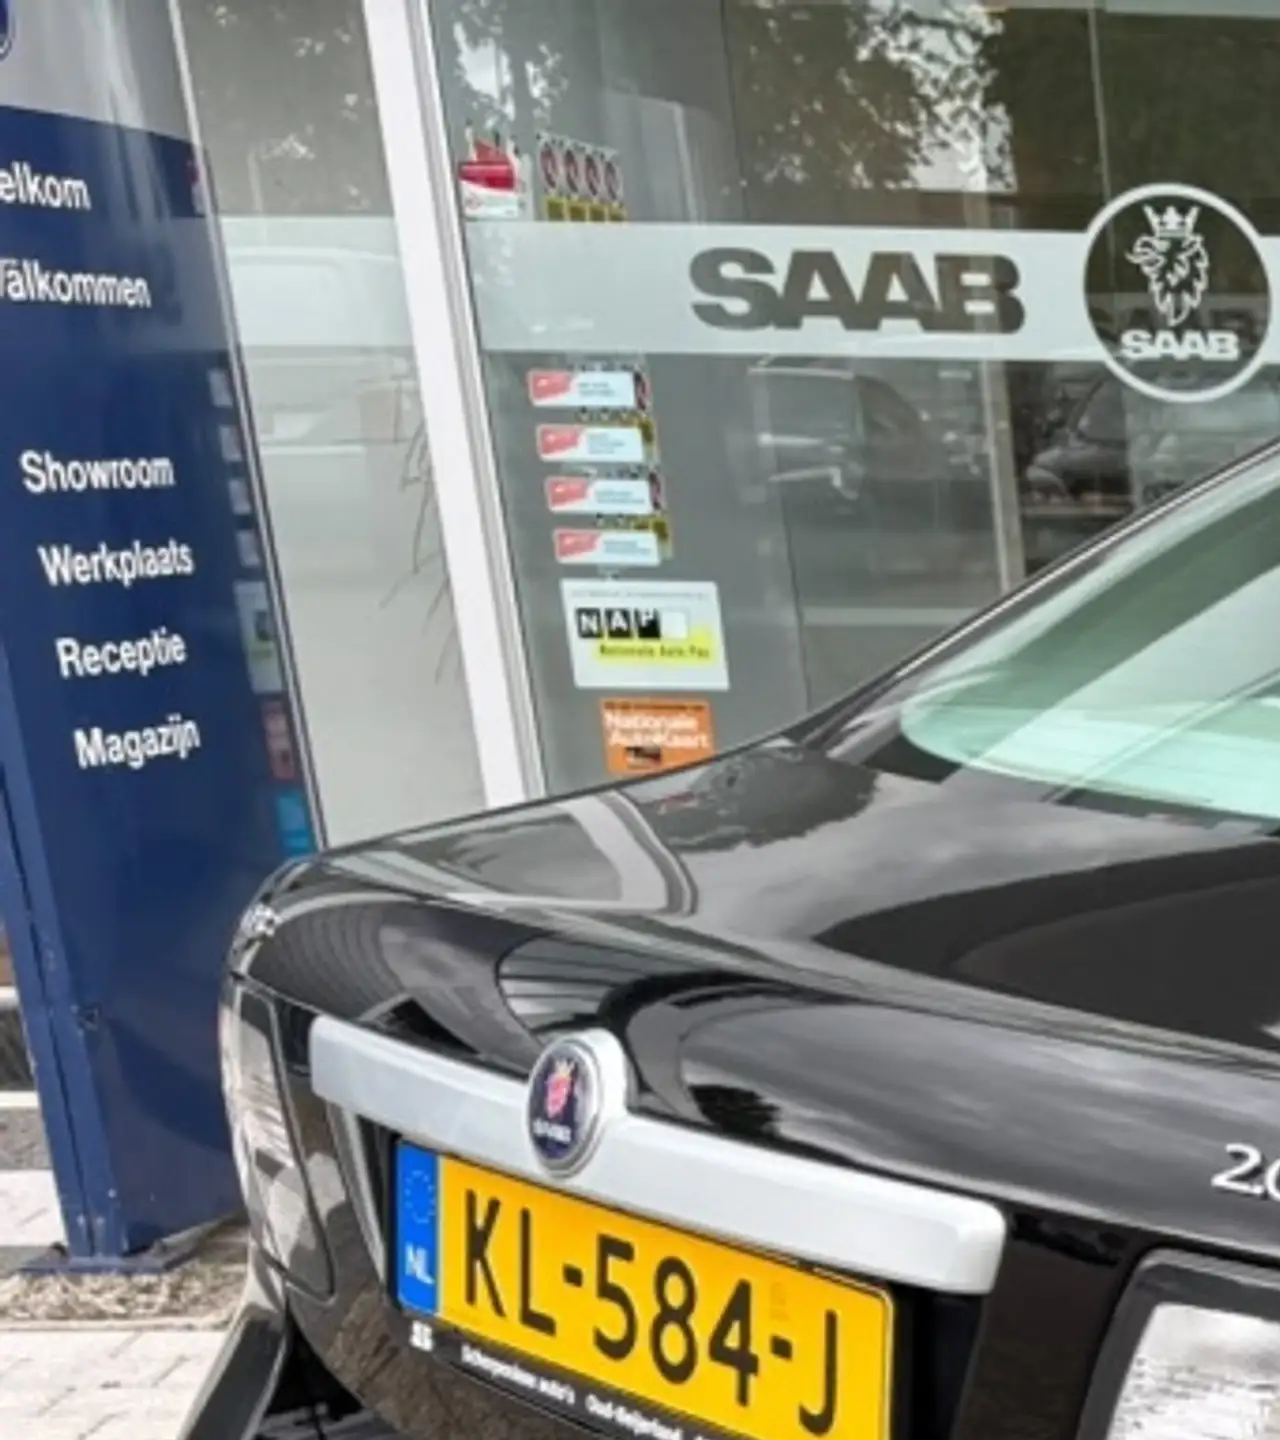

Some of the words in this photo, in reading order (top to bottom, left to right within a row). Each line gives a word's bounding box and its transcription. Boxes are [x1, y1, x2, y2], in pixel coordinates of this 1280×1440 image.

[0, 162, 91, 210] elkom
[688, 247, 1025, 335] SAAB
[1120, 329, 1240, 361] SAAB
[19, 450, 175, 494] Showroom
[37, 537, 194, 588] Werkplaats
[55, 626, 188, 678] Receptie
[73, 713, 201, 770] Magazijn
[404, 1241, 436, 1286] NL
[463, 1187, 841, 1437] KL-584-J
